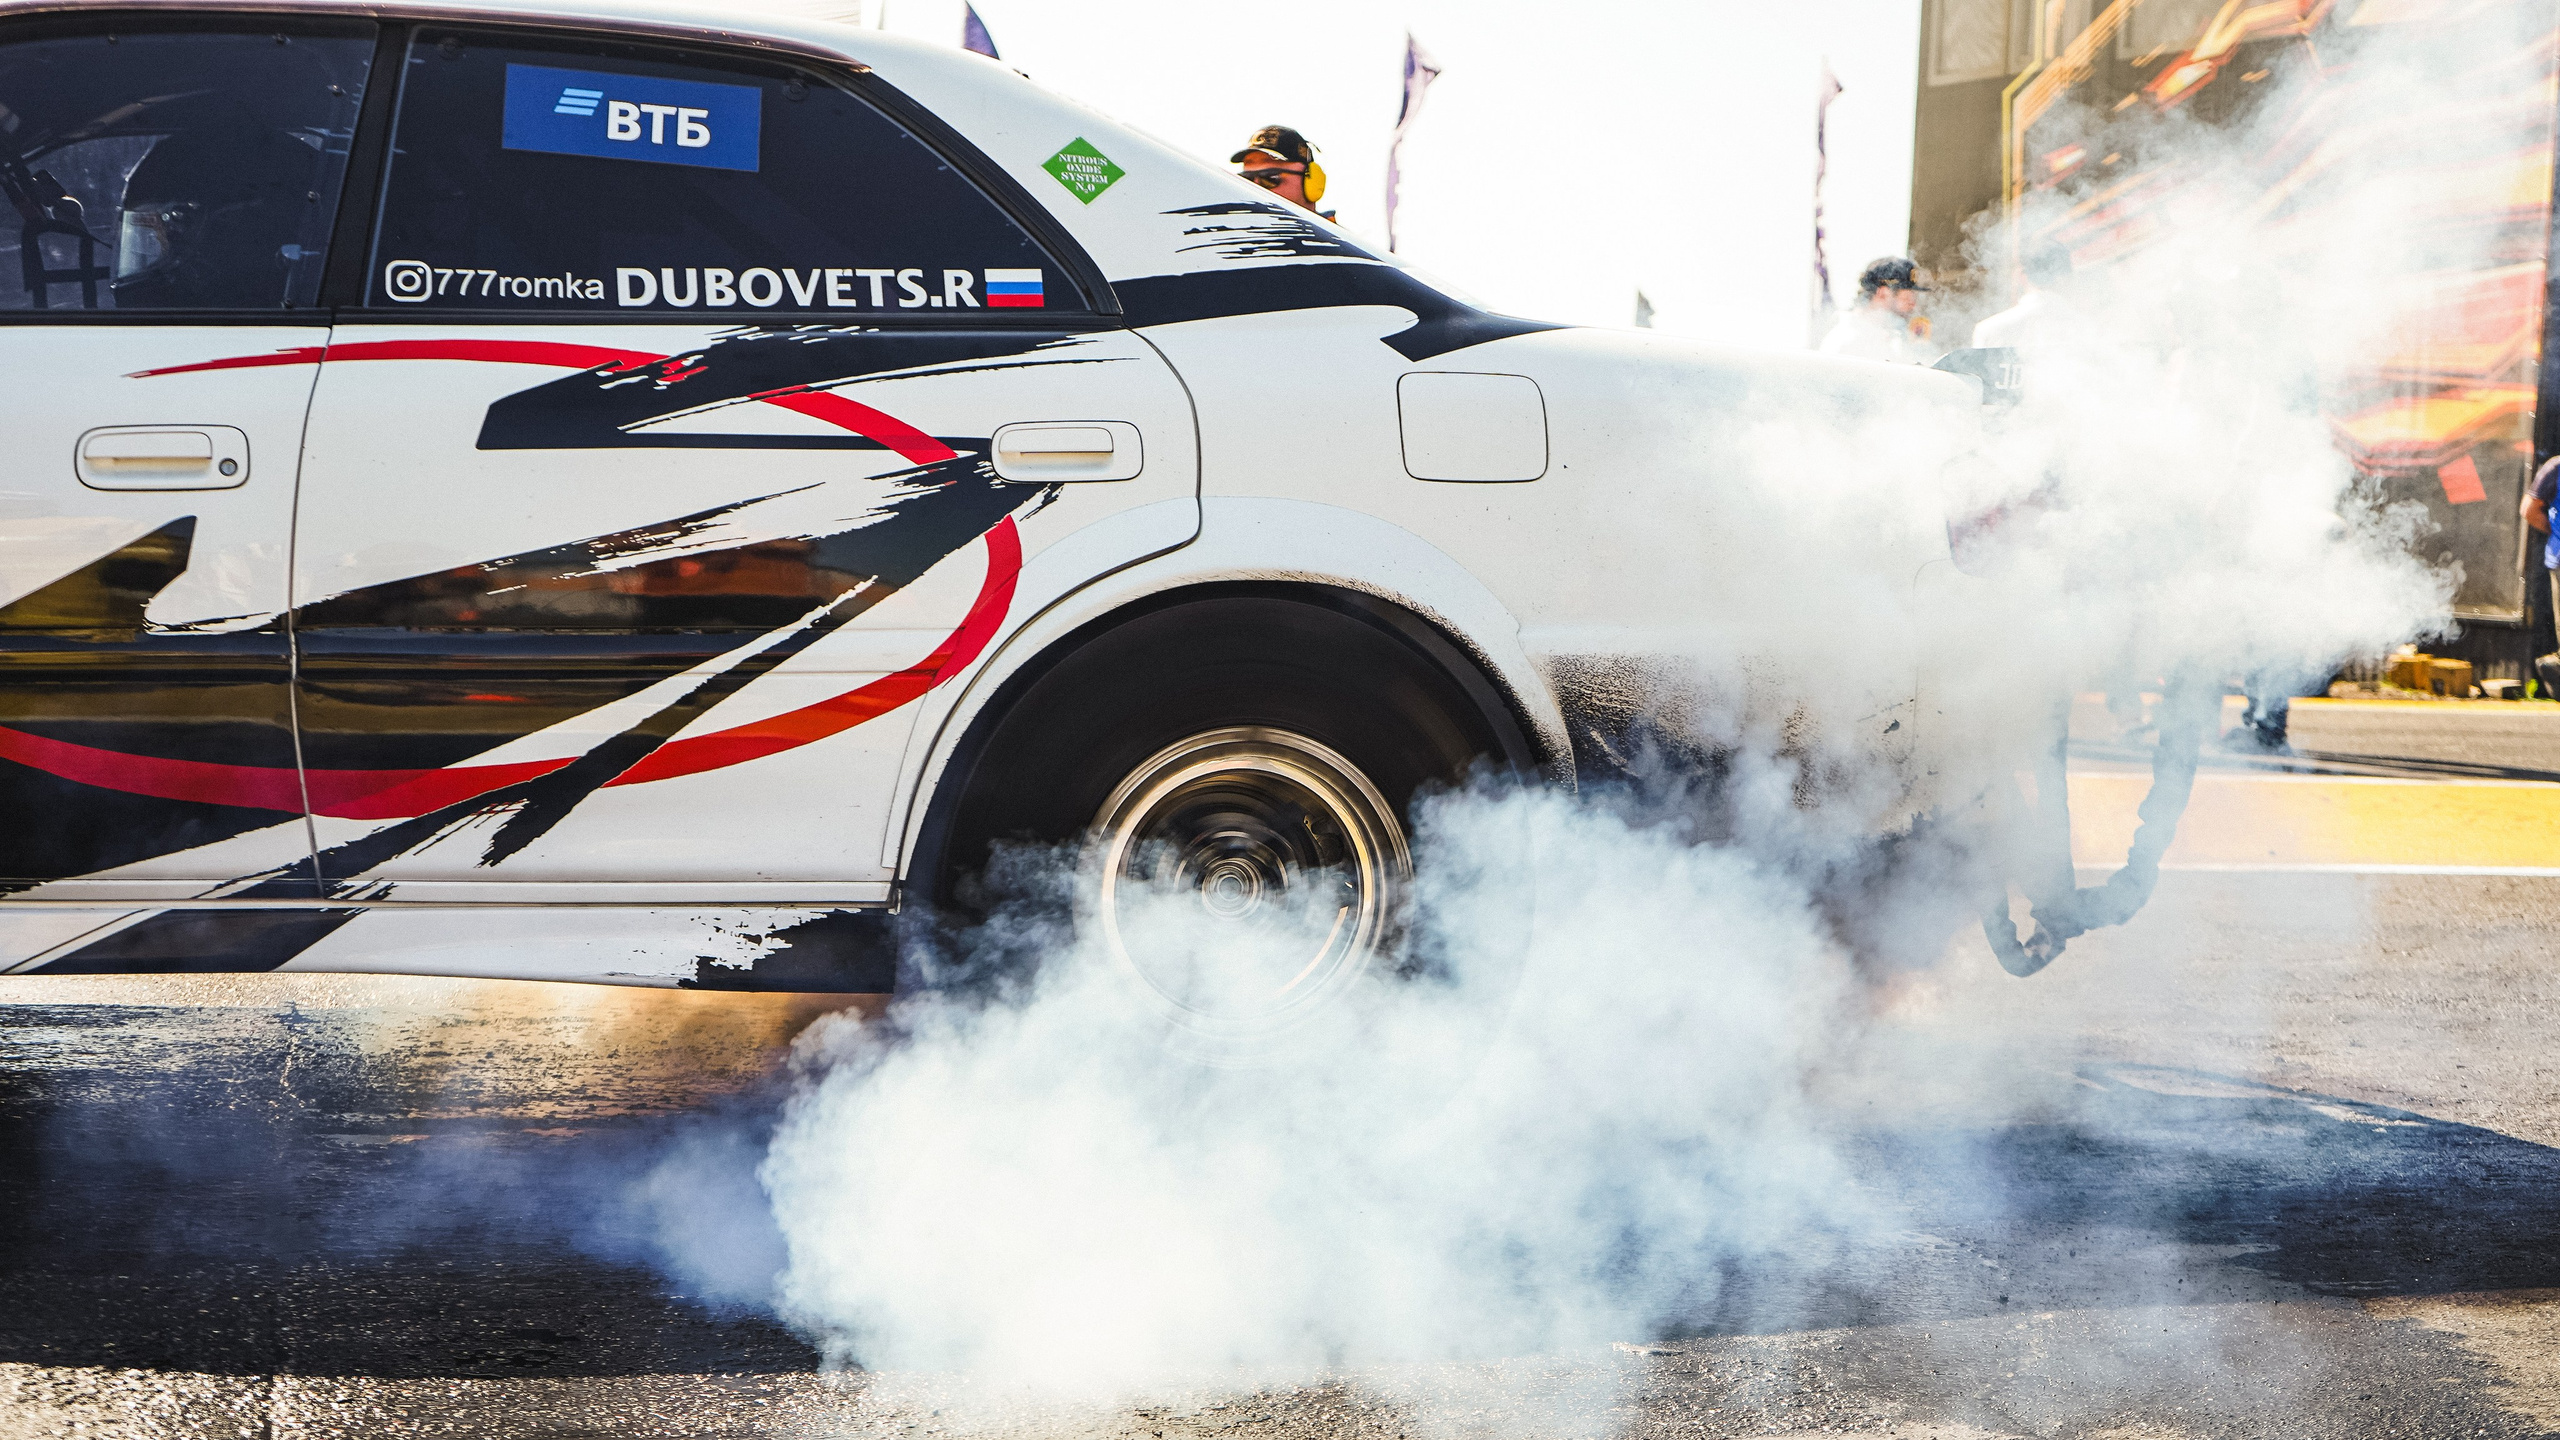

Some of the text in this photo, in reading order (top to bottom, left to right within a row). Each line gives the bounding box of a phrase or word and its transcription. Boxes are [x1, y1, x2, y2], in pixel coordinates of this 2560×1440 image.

[607, 100, 711, 148] ВТБ
[1058, 152, 1108, 166] NITROUS
[1066, 163, 1102, 174] OXIDE
[1061, 171, 1108, 184] SYSTEM
[434, 267, 981, 308] 777romka DUBOVETS.R
